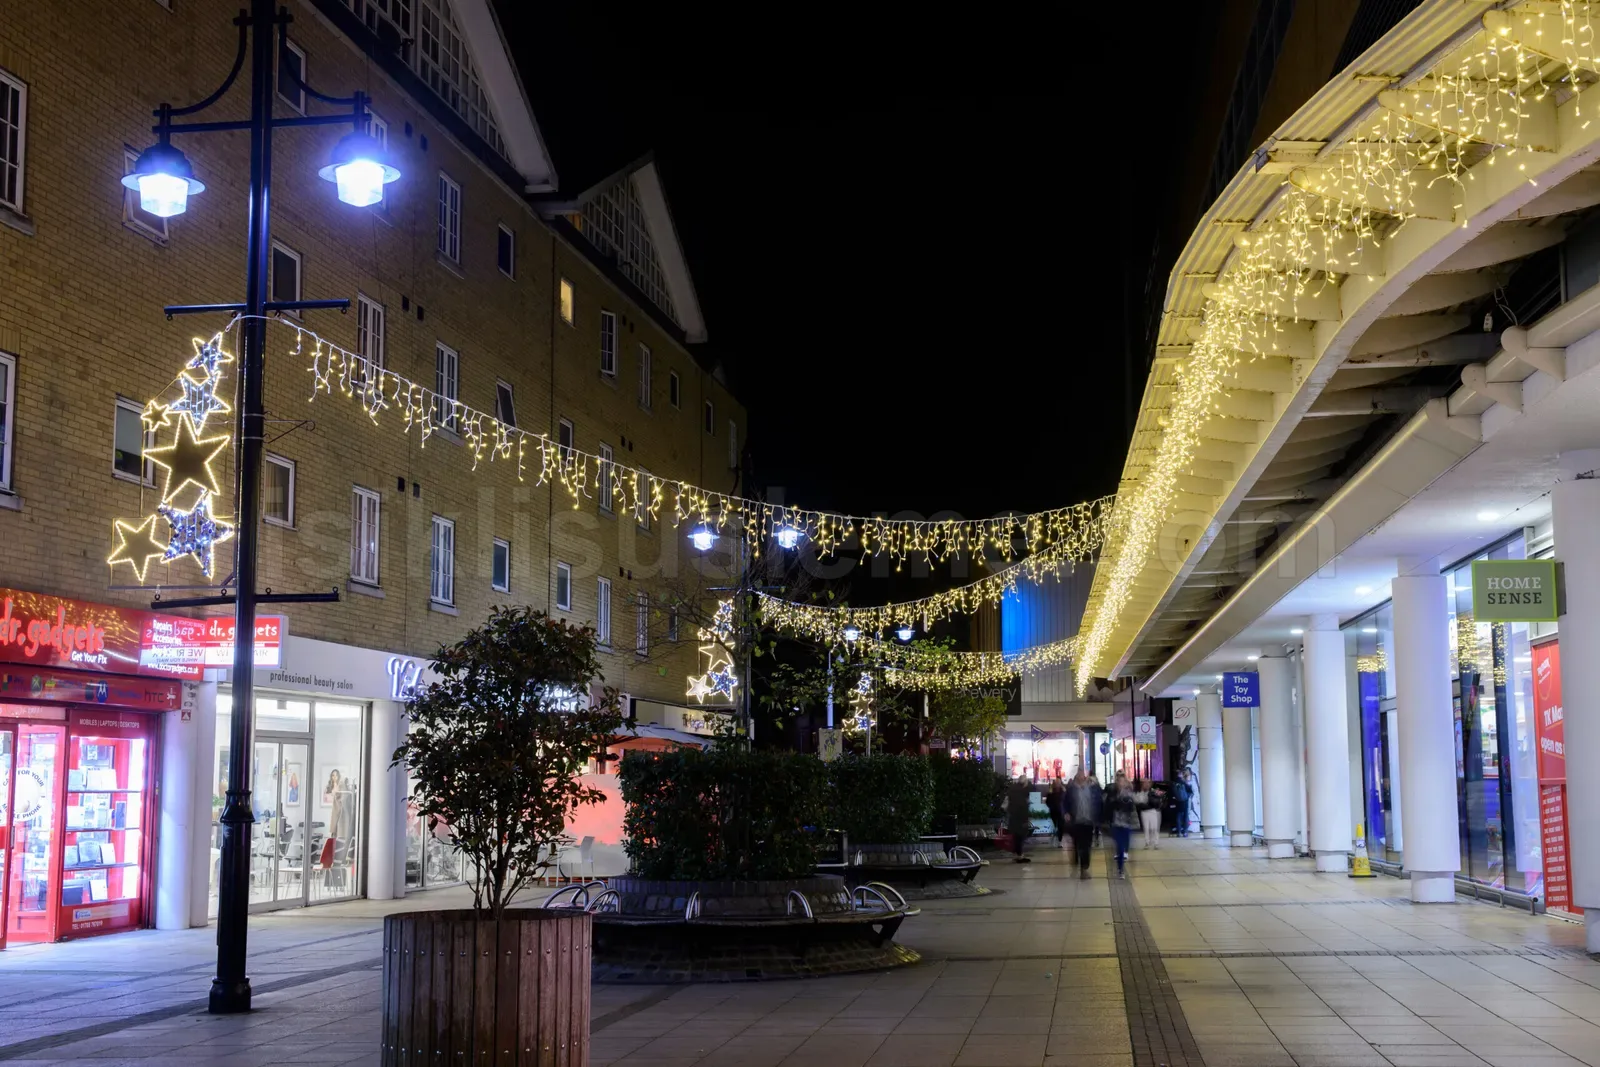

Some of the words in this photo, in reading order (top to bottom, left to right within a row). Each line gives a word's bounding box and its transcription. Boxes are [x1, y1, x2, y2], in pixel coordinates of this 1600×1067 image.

[1486, 576, 1542, 590] HOME
[1487, 592, 1542, 605] SENSE
[71, 651, 83, 662] Get
[84, 652, 98, 663] Your
[270, 671, 312, 686] professional
[314, 676, 335, 690] beauty
[336, 680, 354, 690] salon
[1232, 676, 1248, 684] The
[953, 686, 1017, 702] rewery
[1234, 686, 1248, 695] Toy
[1230, 694, 1252, 704] Shop
[1552, 705, 1563, 723] Ma
[1540, 736, 1554, 754] open
